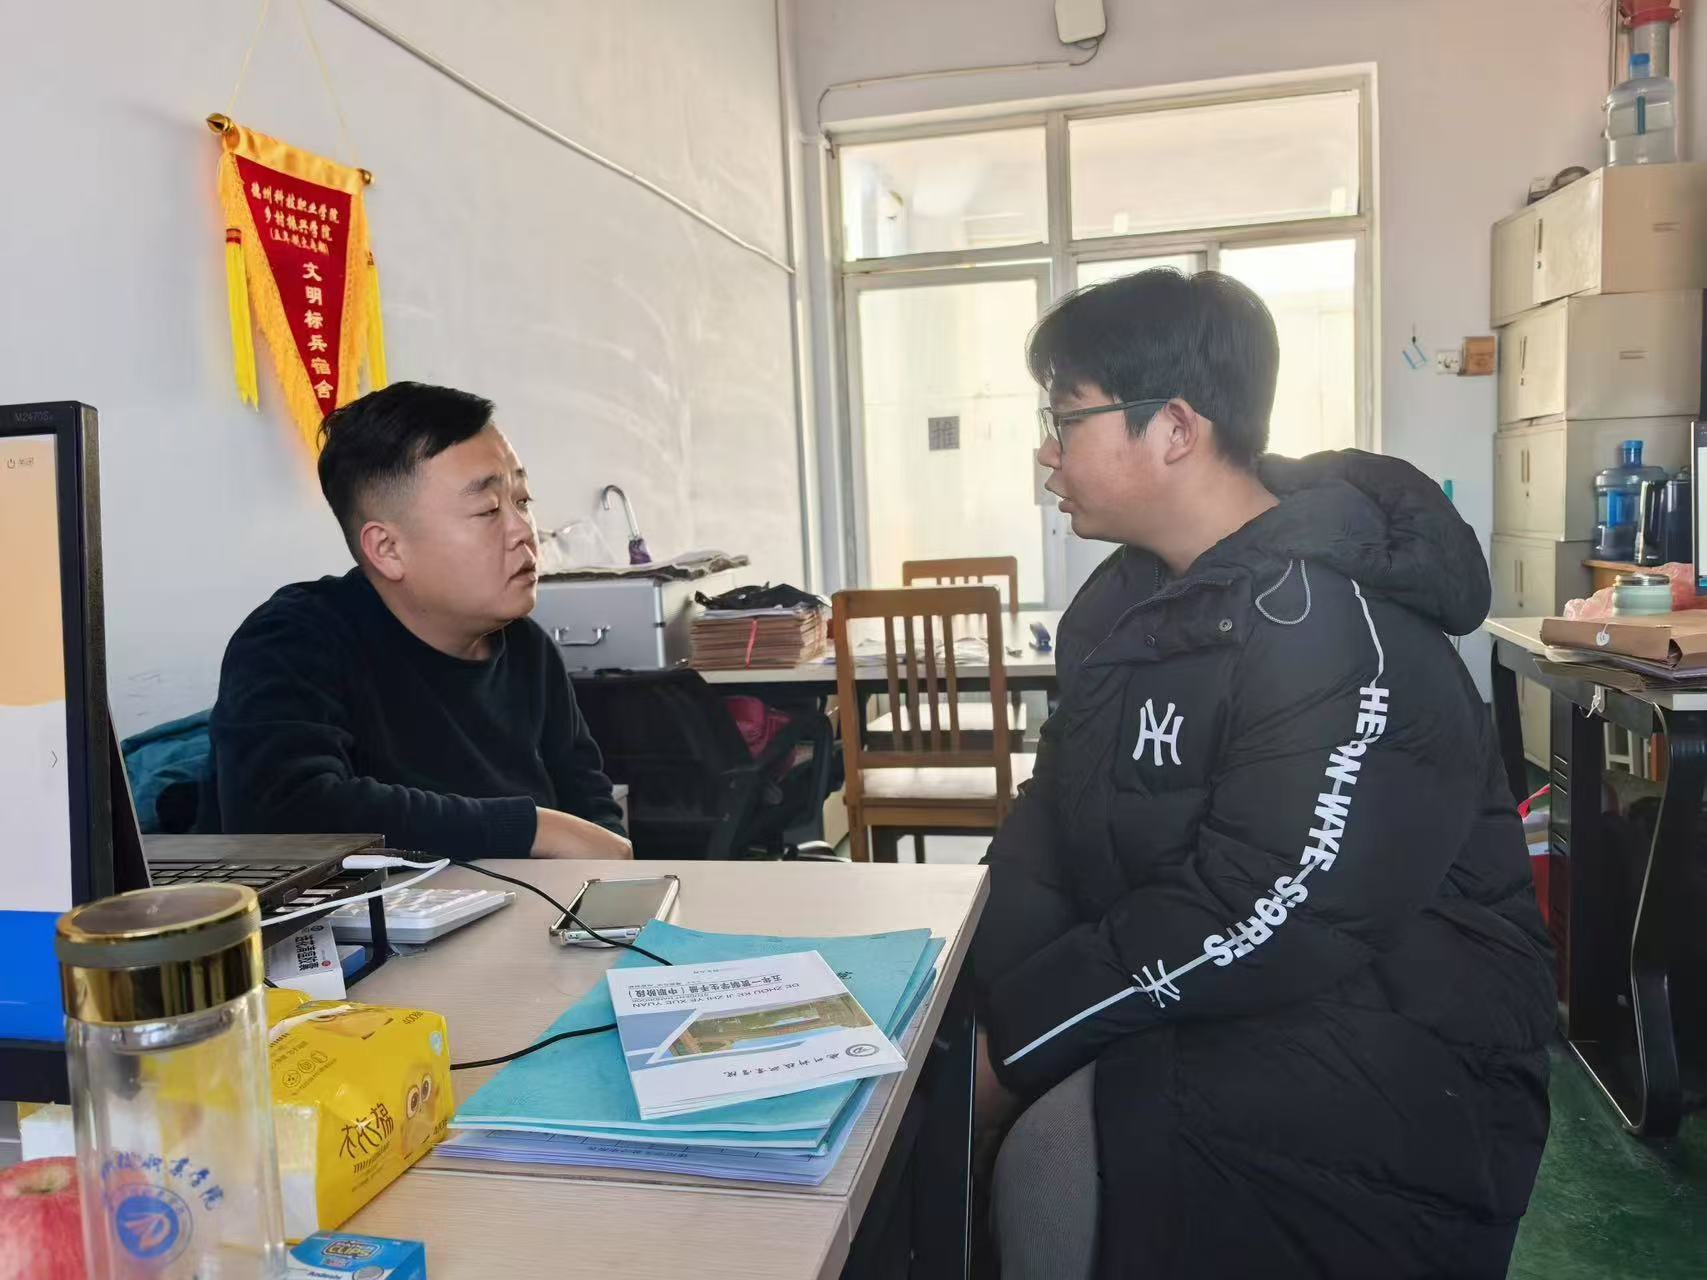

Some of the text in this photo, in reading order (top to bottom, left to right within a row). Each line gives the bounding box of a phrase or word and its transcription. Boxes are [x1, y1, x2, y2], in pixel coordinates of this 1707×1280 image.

[302, 261, 334, 399] 文明标兵宿舍
